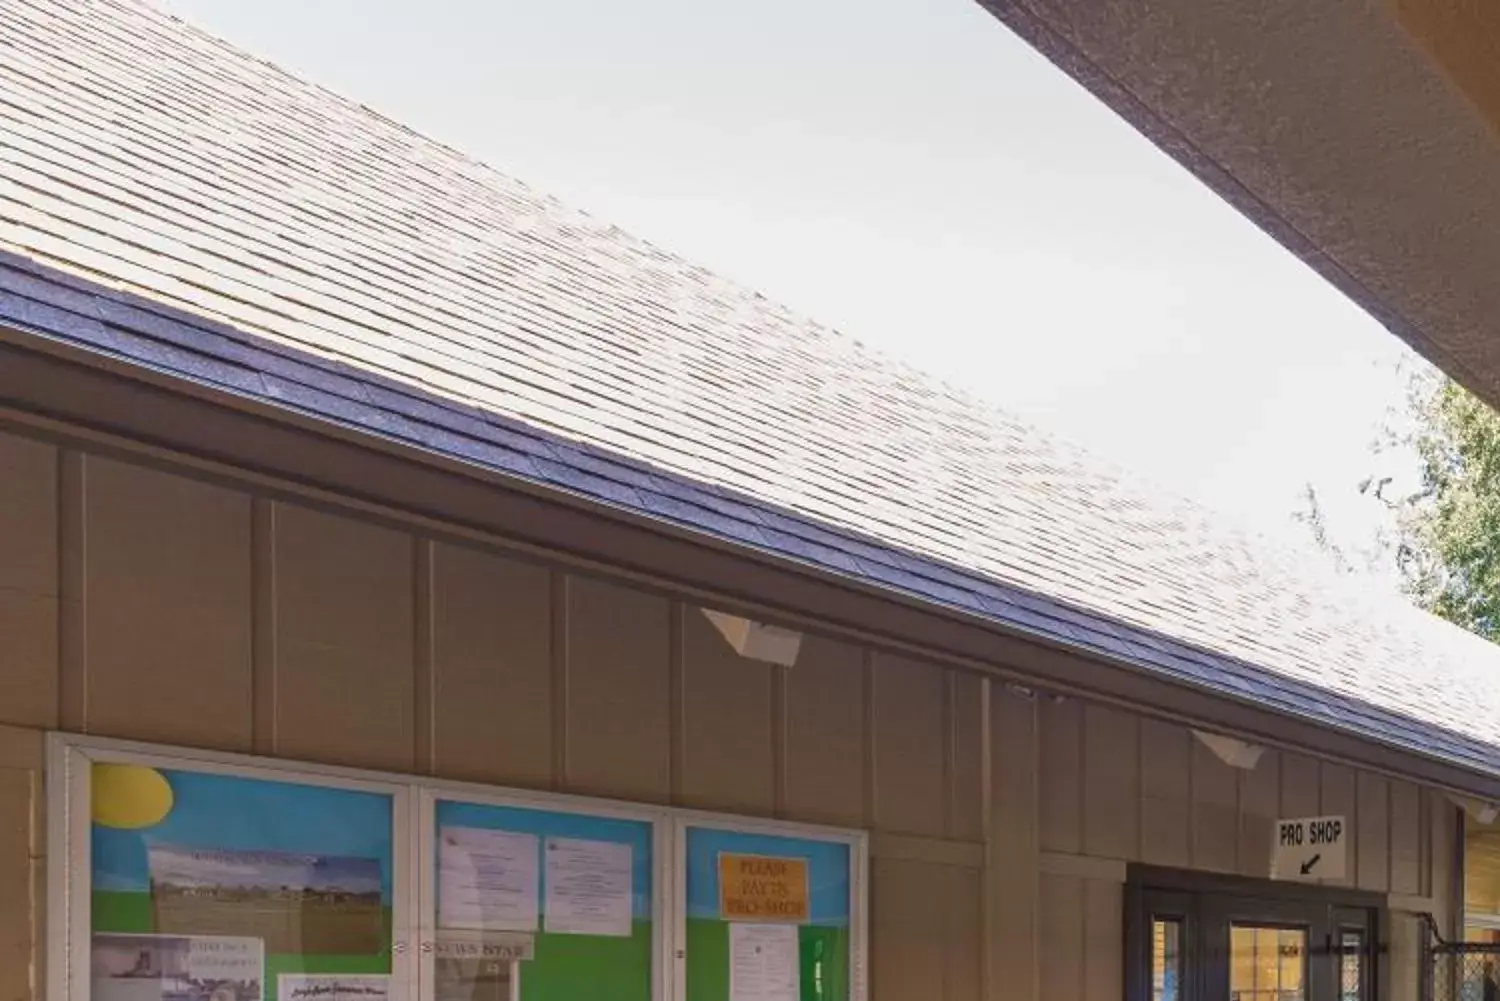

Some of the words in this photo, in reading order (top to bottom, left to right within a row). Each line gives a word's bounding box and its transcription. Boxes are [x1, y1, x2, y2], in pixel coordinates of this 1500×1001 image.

[1280, 823, 1303, 846] PRO
[1309, 820, 1342, 845] SHOP
[740, 860, 789, 877] PLEASE
